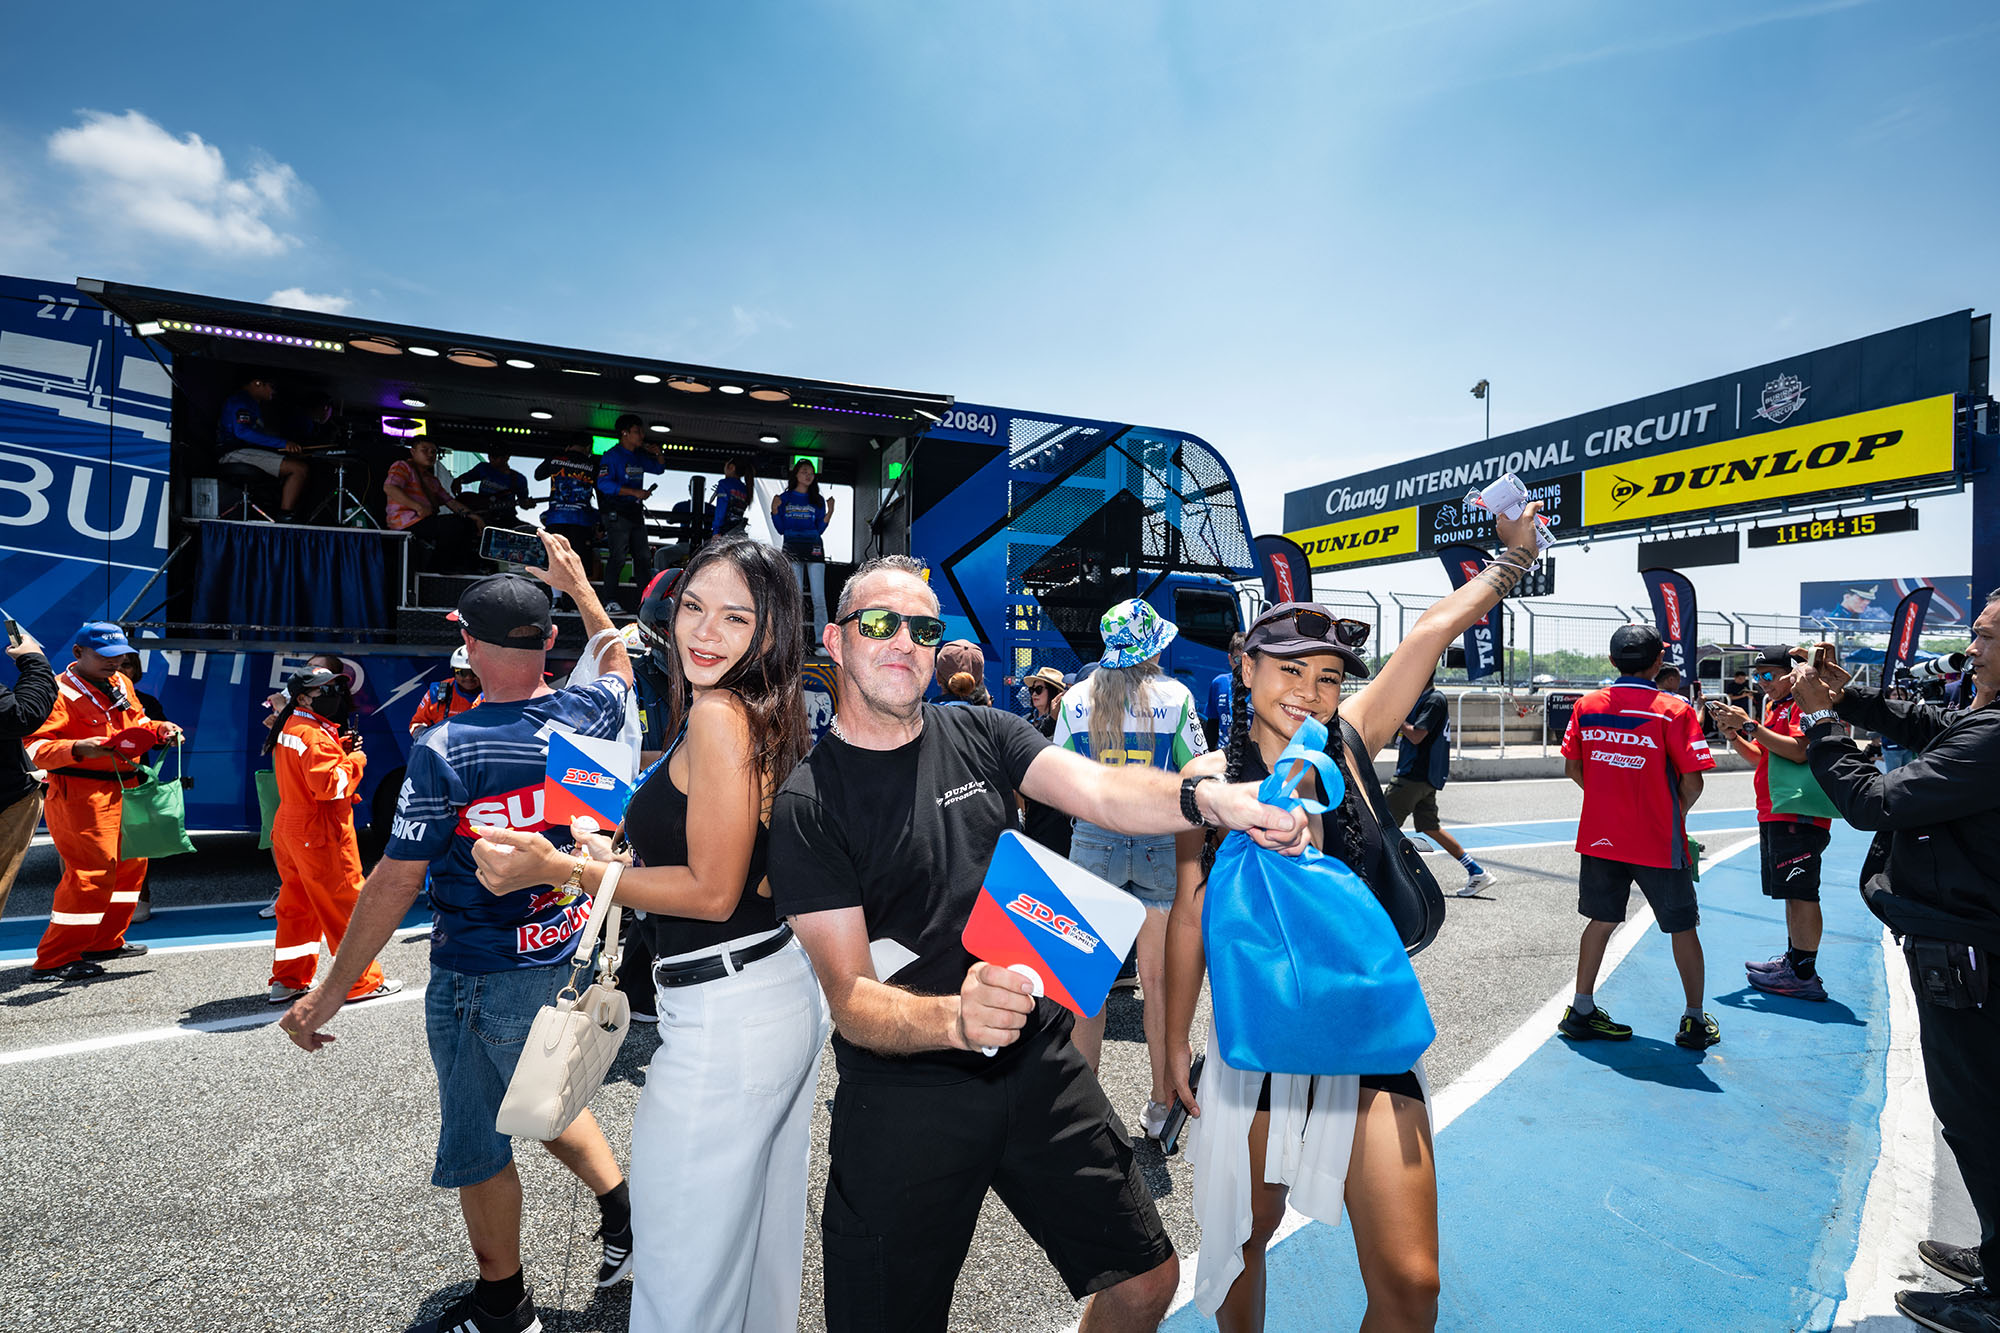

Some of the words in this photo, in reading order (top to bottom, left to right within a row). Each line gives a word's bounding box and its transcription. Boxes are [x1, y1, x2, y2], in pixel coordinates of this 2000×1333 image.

[37, 294, 80, 321] 27
[932, 409, 997, 437] 2084)
[1325, 483, 1390, 515] Chang
[1395, 438, 1575, 501] INTERNATIONAL
[1584, 403, 1717, 458] CIRCUIT
[1647, 429, 1904, 498] DUNLOP
[1526, 483, 1561, 502] RACING
[1302, 525, 1400, 557] DUNLOP
[1434, 529, 1474, 545] ROUND
[1477, 527, 1485, 538] 2
[1776, 515, 1876, 544] 11:04:15
[1475, 628, 1495, 669] TVS
[1580, 729, 1658, 749] HONDA
[562, 768, 601, 784] SDG
[1010, 894, 1077, 937] SDG
[1069, 932, 1094, 949] FAMILY
[1071, 927, 1098, 945] RACING
